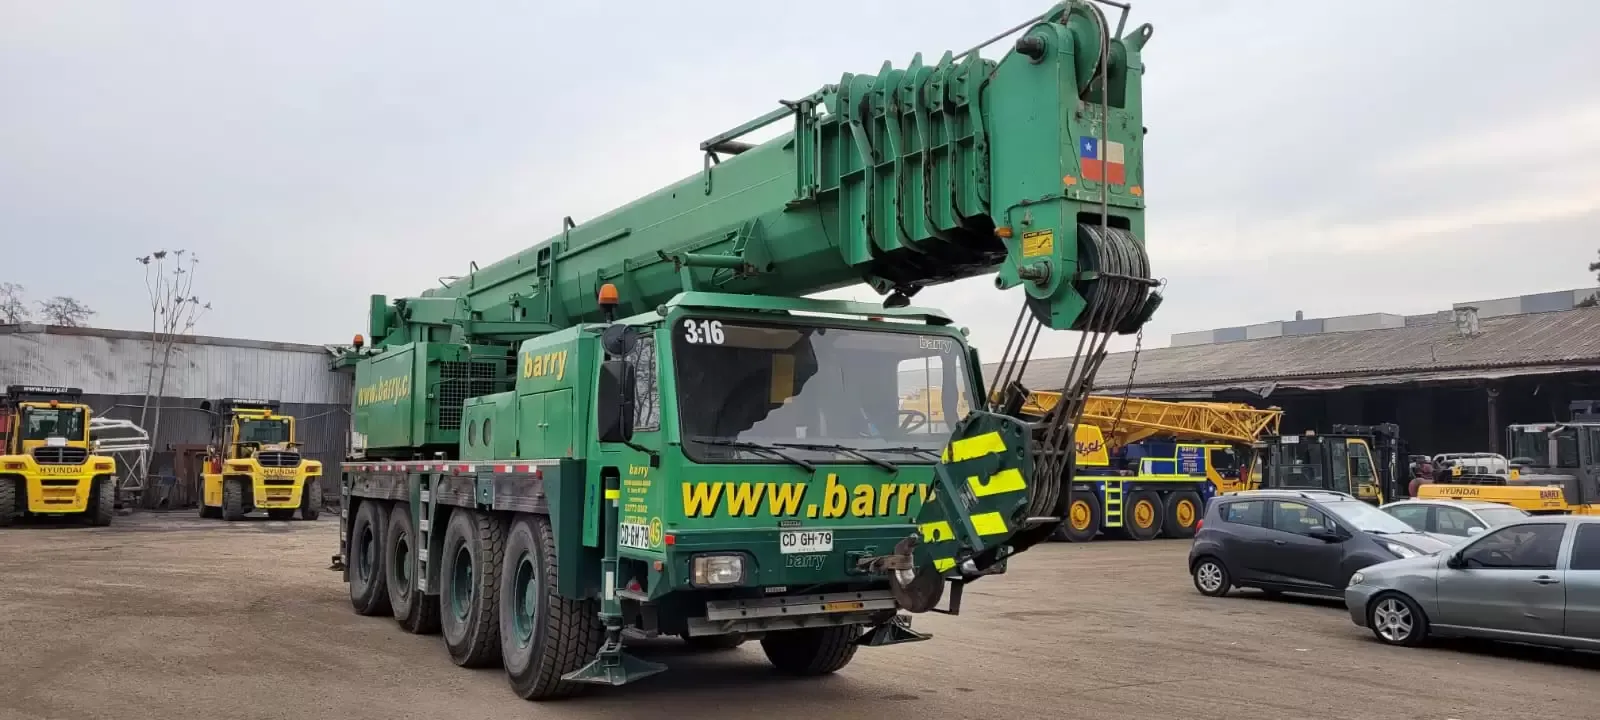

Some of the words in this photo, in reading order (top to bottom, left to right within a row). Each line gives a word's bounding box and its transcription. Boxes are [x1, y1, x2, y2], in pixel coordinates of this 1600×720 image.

[684, 319, 725, 345] 3:16
[920, 335, 953, 354] barry
[524, 350, 568, 382] barry
[23, 386, 69, 394] www.barry.cl
[358, 375, 410, 406] www.barry.c
[40, 466, 82, 474] HYUNDAI
[263, 468, 297, 477] HYUNDAI
[629, 463, 649, 478] barry
[1439, 487, 1480, 497] HYUNDAI
[650, 521, 661, 542] 45
[782, 533, 797, 547] CD
[785, 554, 827, 571] barry
